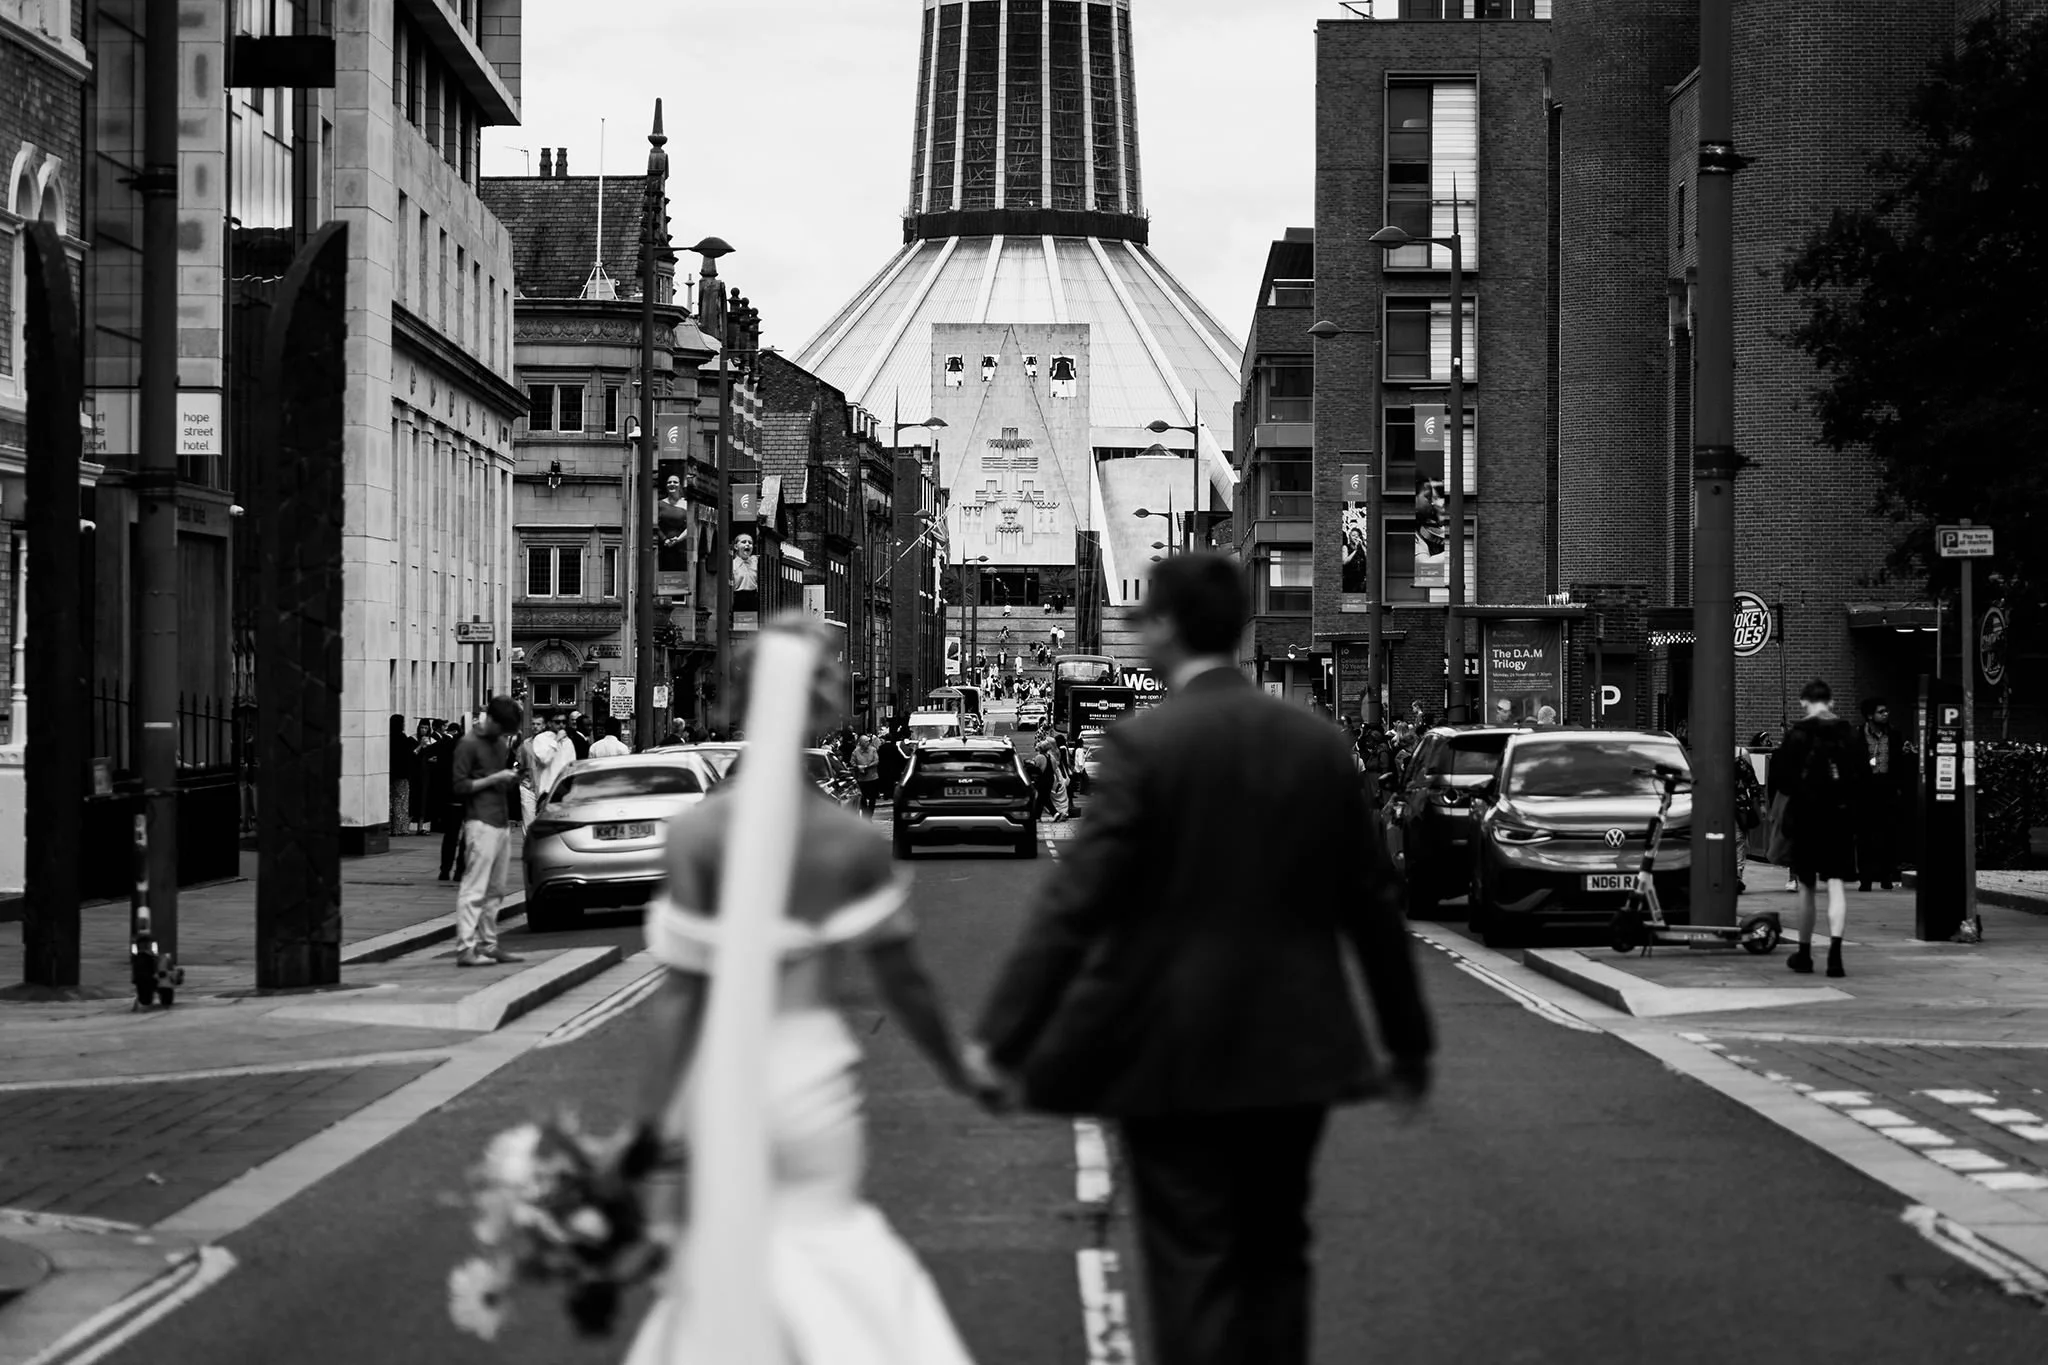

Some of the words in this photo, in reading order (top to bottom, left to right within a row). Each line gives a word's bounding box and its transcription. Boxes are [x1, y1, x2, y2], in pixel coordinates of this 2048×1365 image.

[183, 412, 210, 424] hope
[183, 426, 214, 436] street
[183, 440, 209, 450] hotel
[1946, 533, 1956, 546] P
[1733, 610, 1768, 628] OKEY
[1733, 626, 1764, 645] OES
[1492, 649, 1512, 658] The
[1513, 649, 1543, 658] D.A.M
[1492, 659, 1527, 671] Trilogy
[1601, 685, 1621, 716] P
[1944, 708, 1959, 724] P
[1592, 875, 1620, 888] ND61
